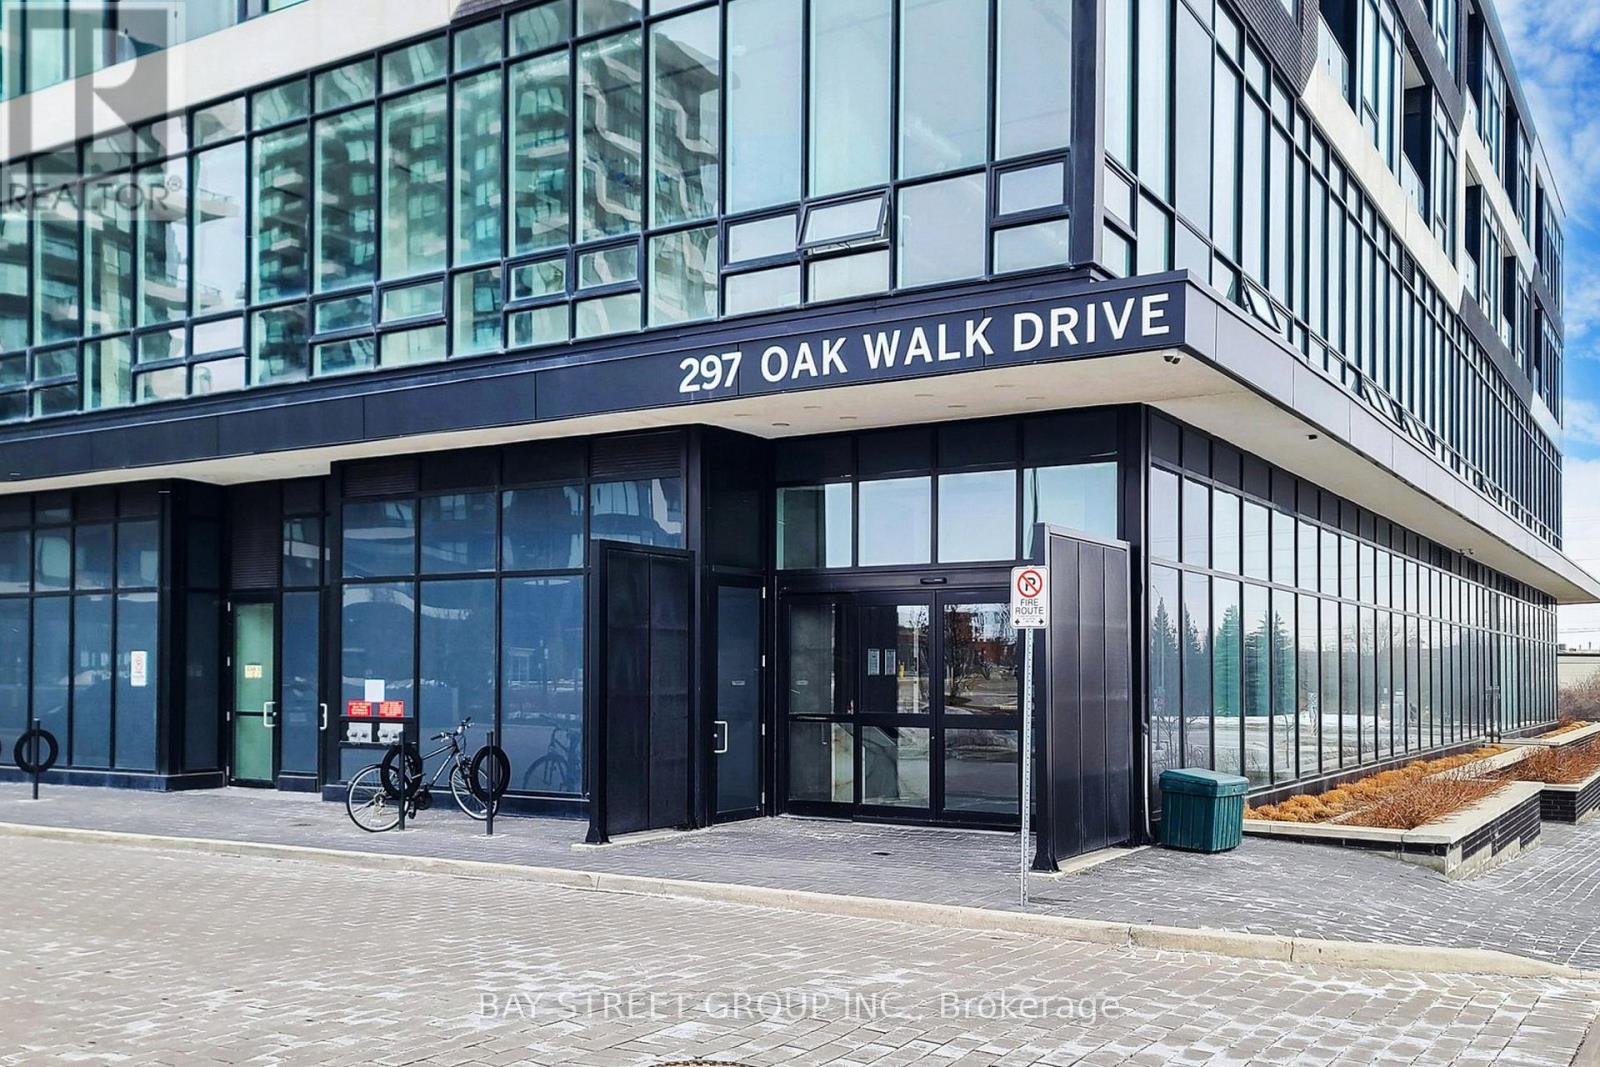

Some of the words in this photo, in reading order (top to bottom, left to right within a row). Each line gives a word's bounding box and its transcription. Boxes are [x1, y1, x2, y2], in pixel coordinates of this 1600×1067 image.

[679, 351, 742, 393] 297
[760, 337, 848, 383] OAK
[862, 317, 994, 370] WALK
[1013, 293, 1170, 352] DRIVE
[1020, 598, 1039, 606] FIRE
[1015, 606, 1044, 615] ROUTE
